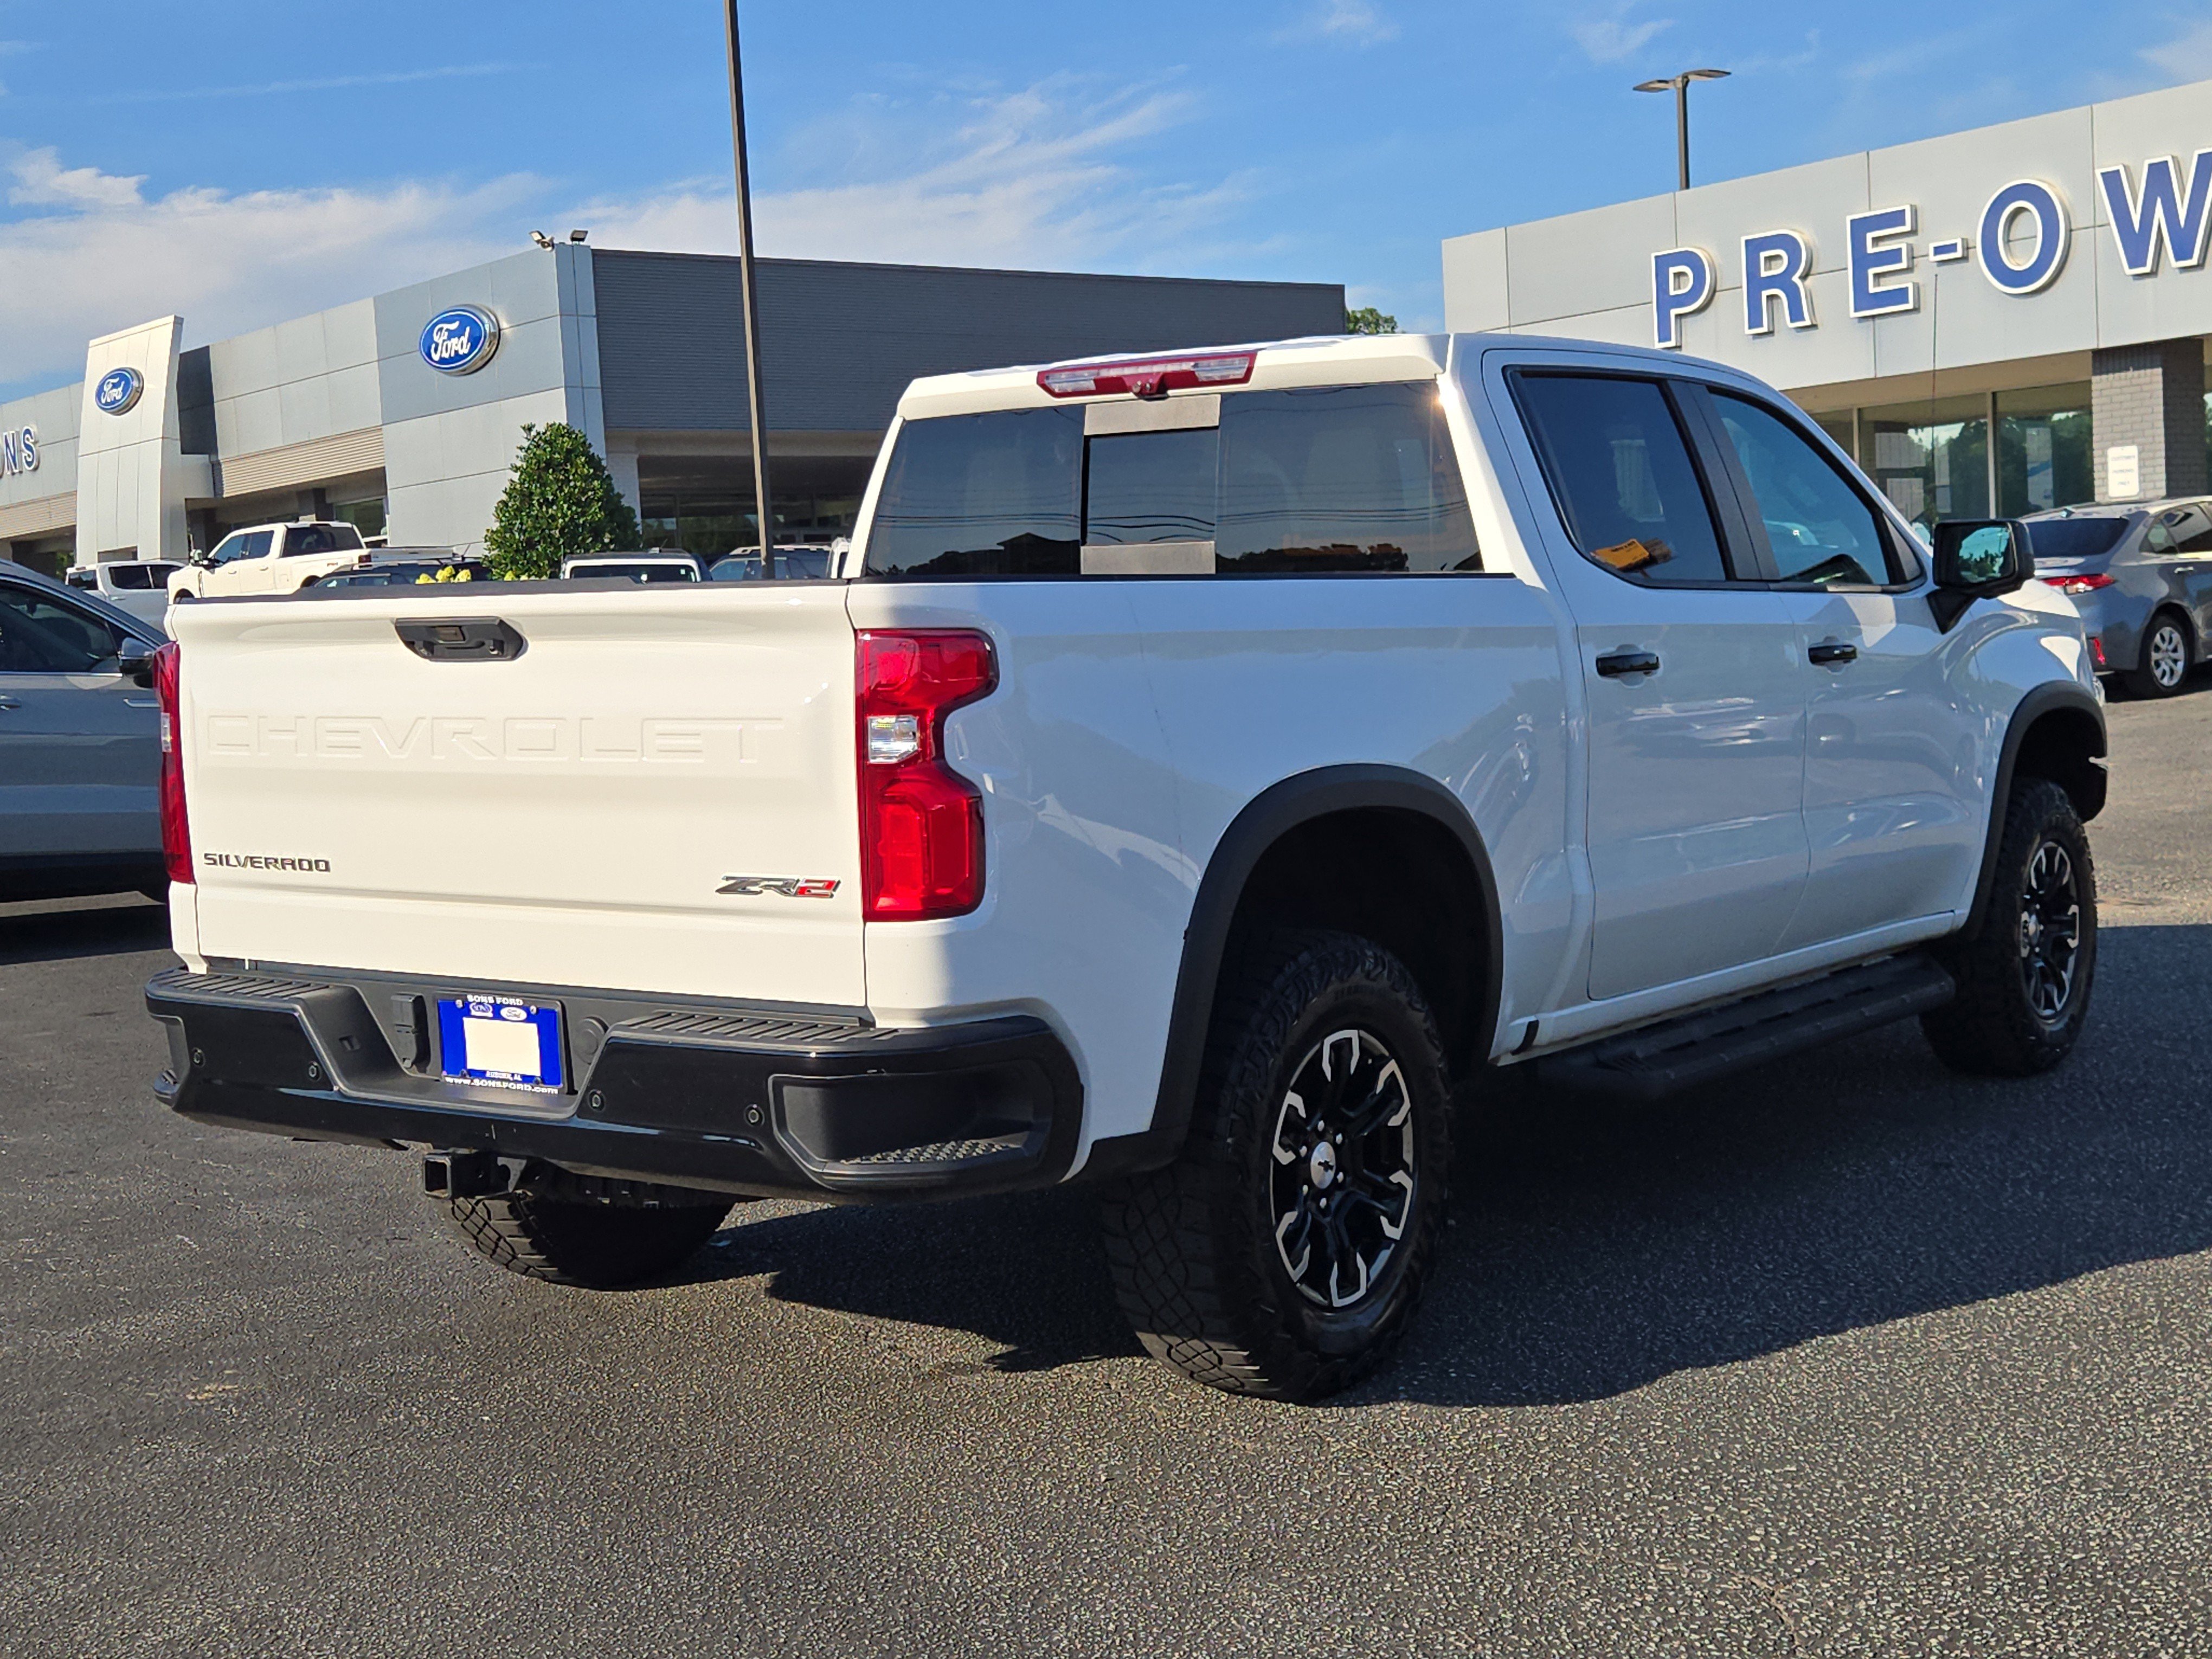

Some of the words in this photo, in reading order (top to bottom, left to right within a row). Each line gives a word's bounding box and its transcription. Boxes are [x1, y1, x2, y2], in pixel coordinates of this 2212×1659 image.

[1650, 147, 2212, 349] PRE-OW
[430, 320, 471, 362] Ford
[101, 377, 125, 403] Ford
[0, 426, 39, 477] NS
[207, 715, 783, 763] CHEVROLET
[203, 853, 331, 873] SILVERADO
[715, 875, 841, 899] ZR2
[496, 997, 524, 1006] FORD
